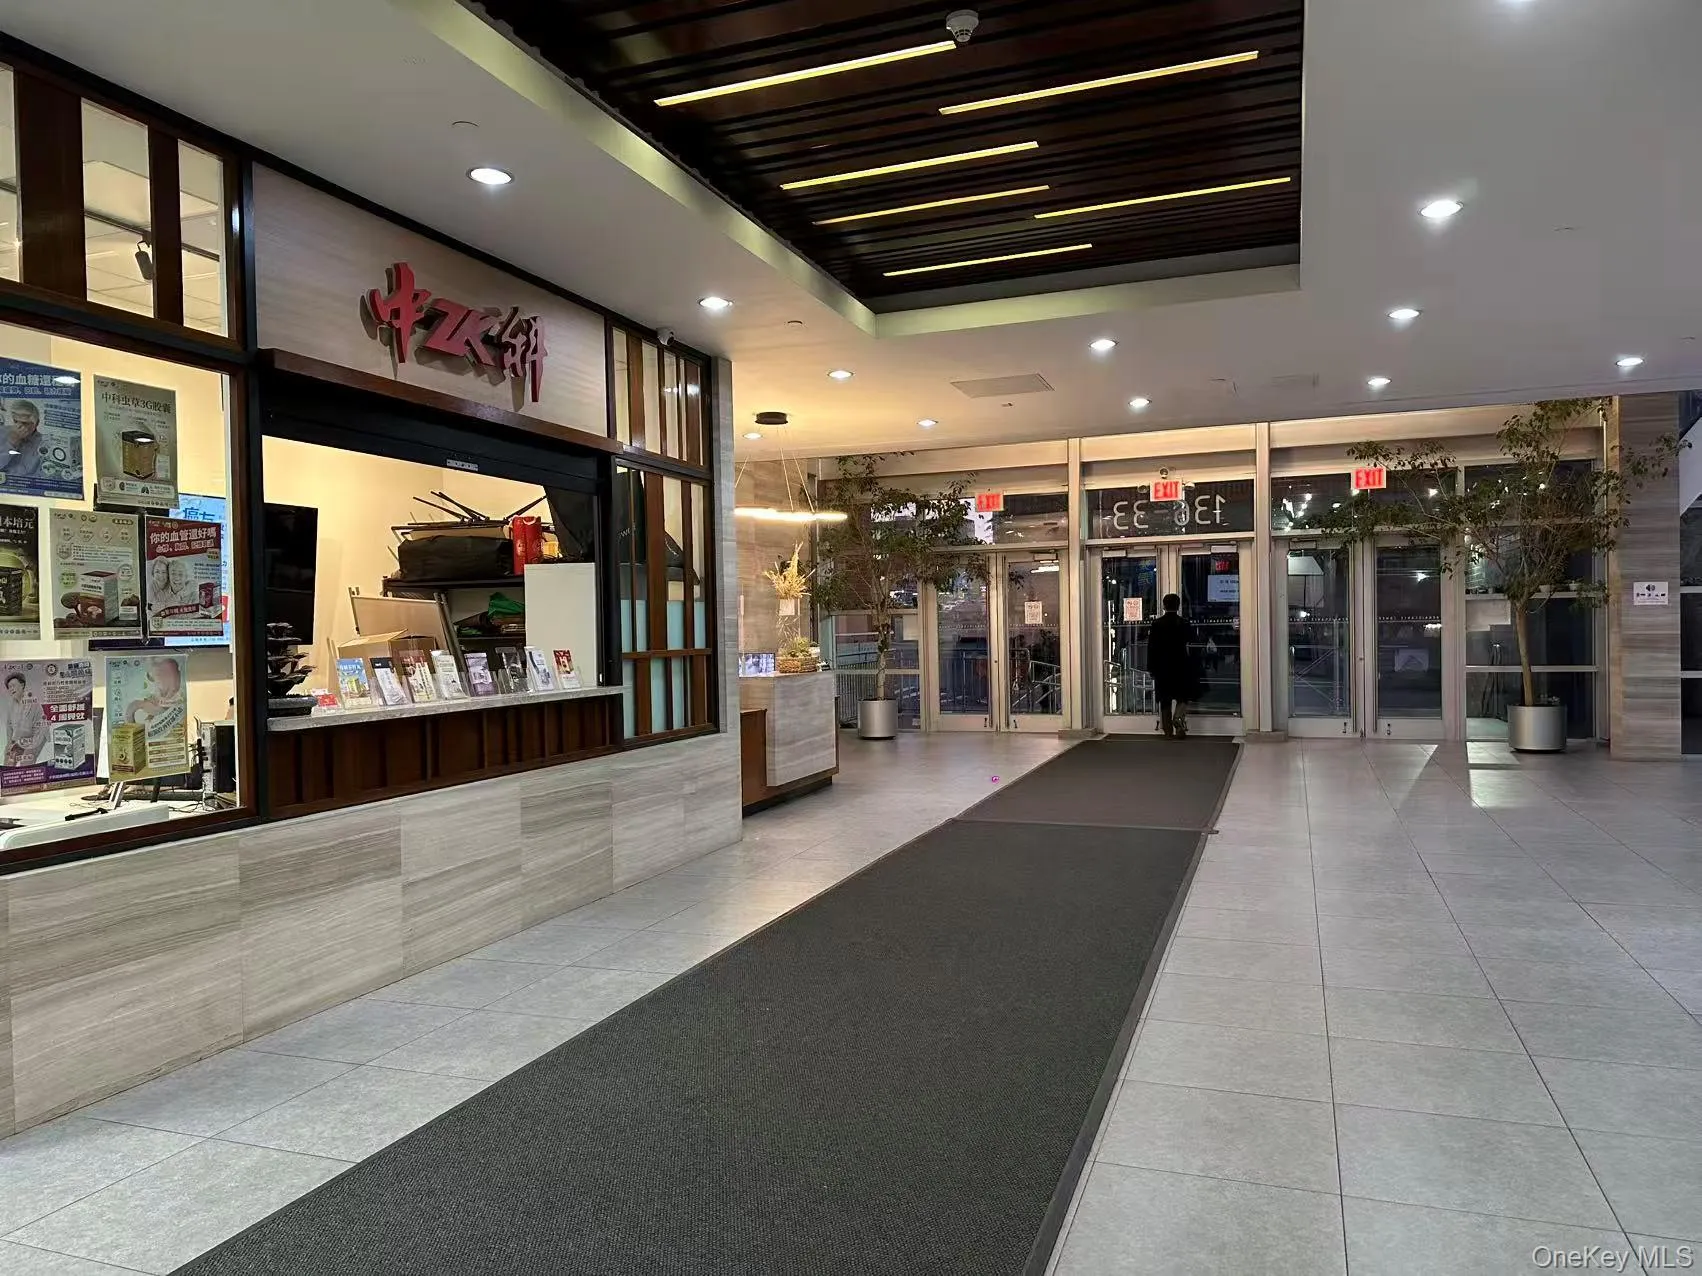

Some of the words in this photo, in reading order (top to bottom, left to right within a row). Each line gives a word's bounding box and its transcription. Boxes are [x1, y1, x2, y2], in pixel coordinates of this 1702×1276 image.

[1355, 468, 1384, 488] EXIT
[1154, 481, 1179, 499] EXIT
[977, 494, 1001, 511] EXIT
[0, 515, 34, 529] 本培元
